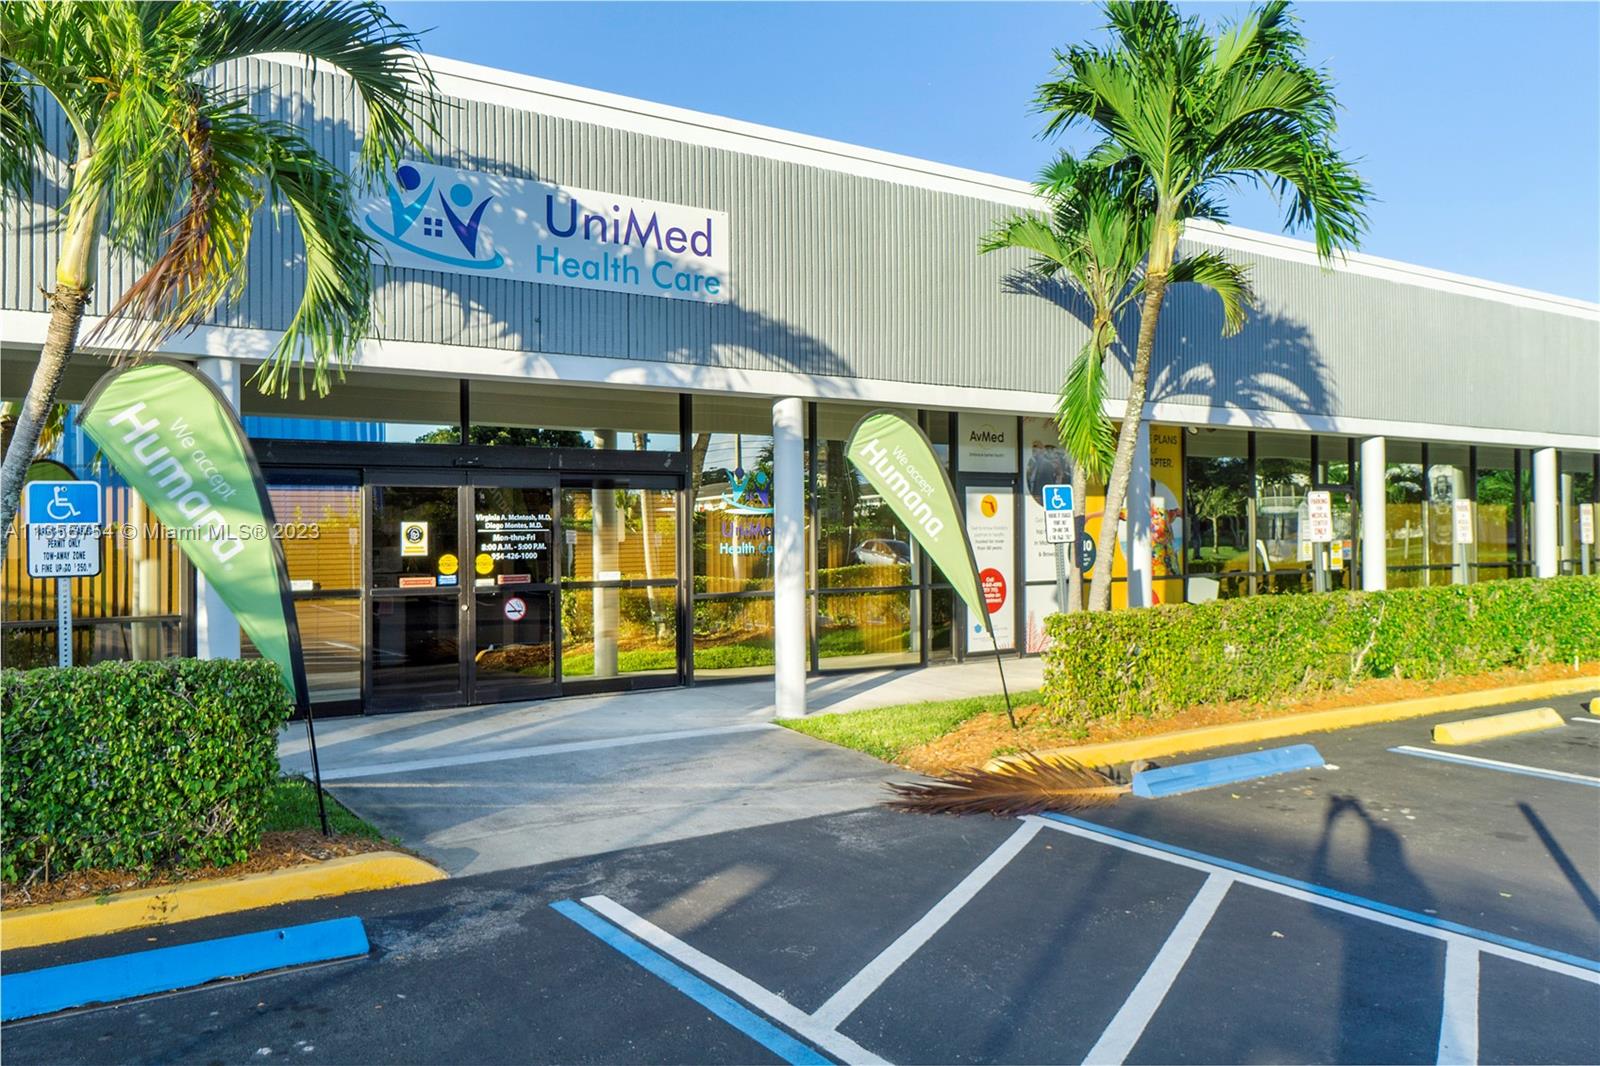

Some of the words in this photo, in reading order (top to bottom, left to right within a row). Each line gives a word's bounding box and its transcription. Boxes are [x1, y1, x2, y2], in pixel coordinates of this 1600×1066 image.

[546, 194, 712, 257] UniMed
[536, 244, 639, 285] Health
[652, 261, 721, 295] Care
[969, 430, 1005, 443] AvMed
[1153, 434, 1177, 445] PLANS
[170, 416, 195, 449] We
[192, 449, 238, 502] accept
[892, 445, 908, 466] We
[906, 464, 935, 497] accept
[106, 401, 245, 564] Humana
[859, 438, 944, 538] Humana
[475, 513, 500, 522] Virginia
[485, 522, 504, 530] Diego
[722, 520, 774, 538] UniMe
[47, 540, 65, 548] PERMIT
[68, 539, 81, 547] ONLY
[481, 543, 497, 551] 8:00
[720, 541, 755, 555] Health
[43, 551, 70, 560] TOW-AWAY
[72, 551, 86, 560] ZONE
[491, 552, 538, 560] 954-426-1000
[41, 563, 53, 573] FINE
